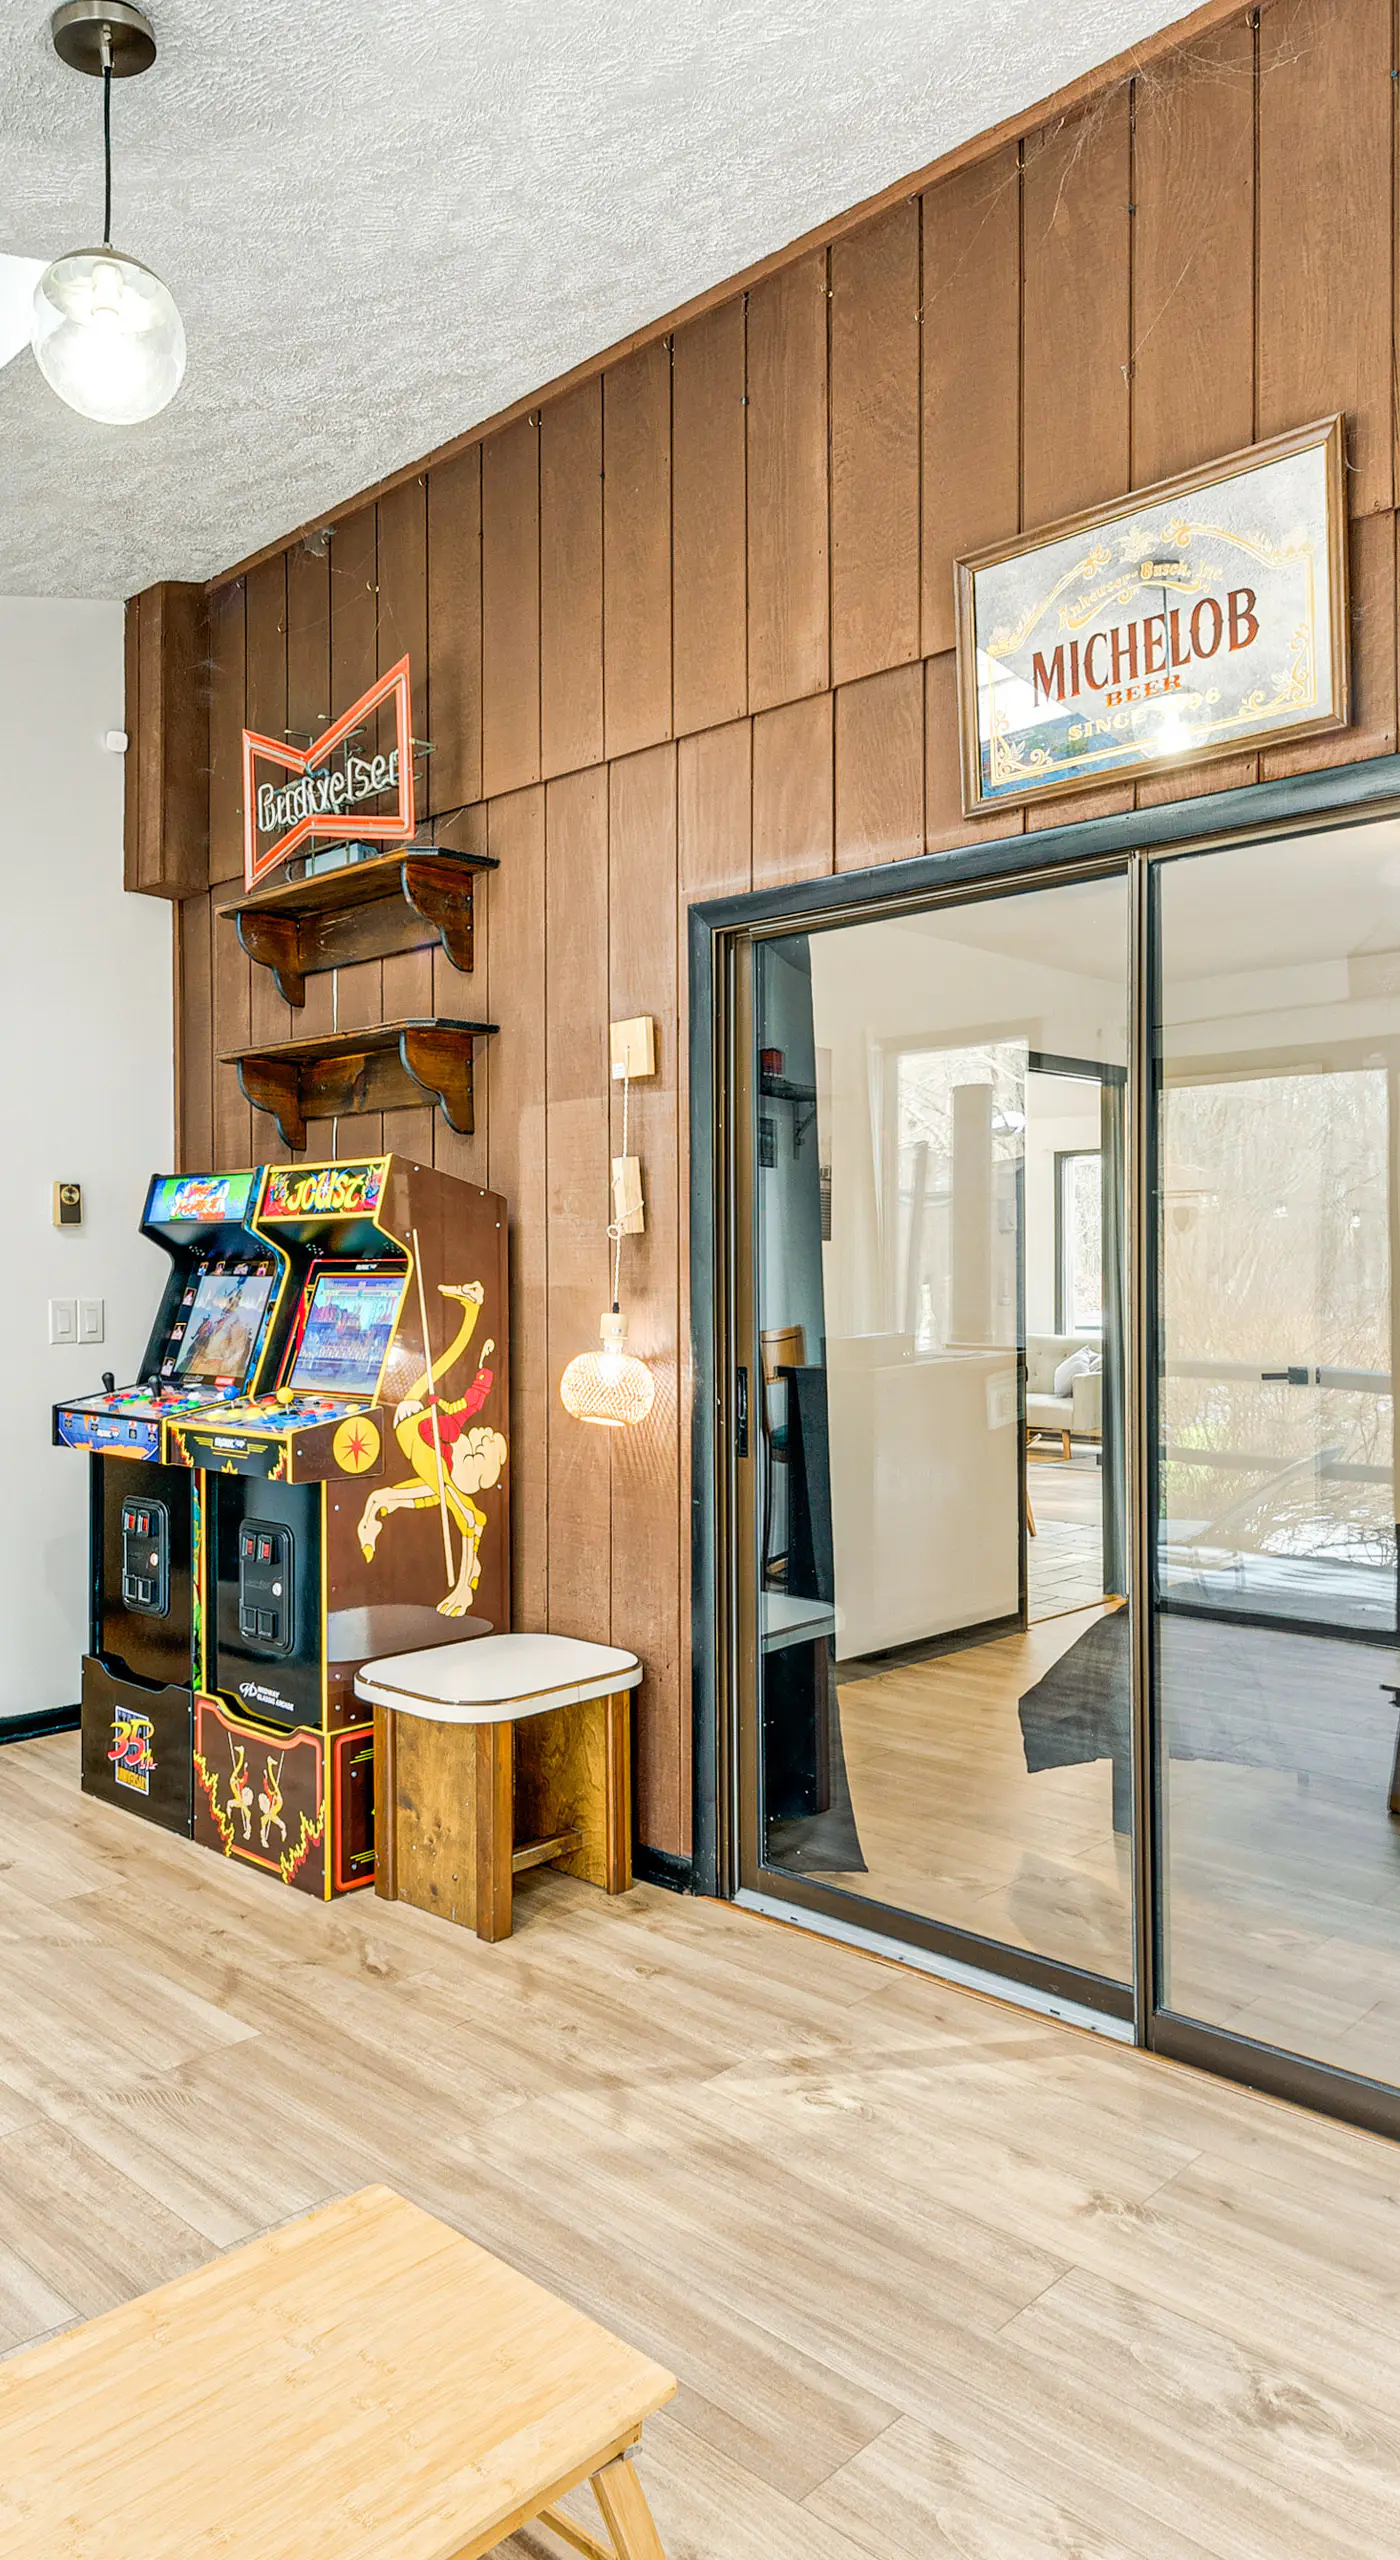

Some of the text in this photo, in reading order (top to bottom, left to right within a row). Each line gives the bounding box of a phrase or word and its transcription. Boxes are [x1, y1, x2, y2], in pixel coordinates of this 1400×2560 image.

[1032, 587, 1260, 707] MICHELOB
[1105, 674, 1182, 709] BEER
[1068, 708, 1148, 742] SINCE
[286, 1171, 365, 1212] JOUST
